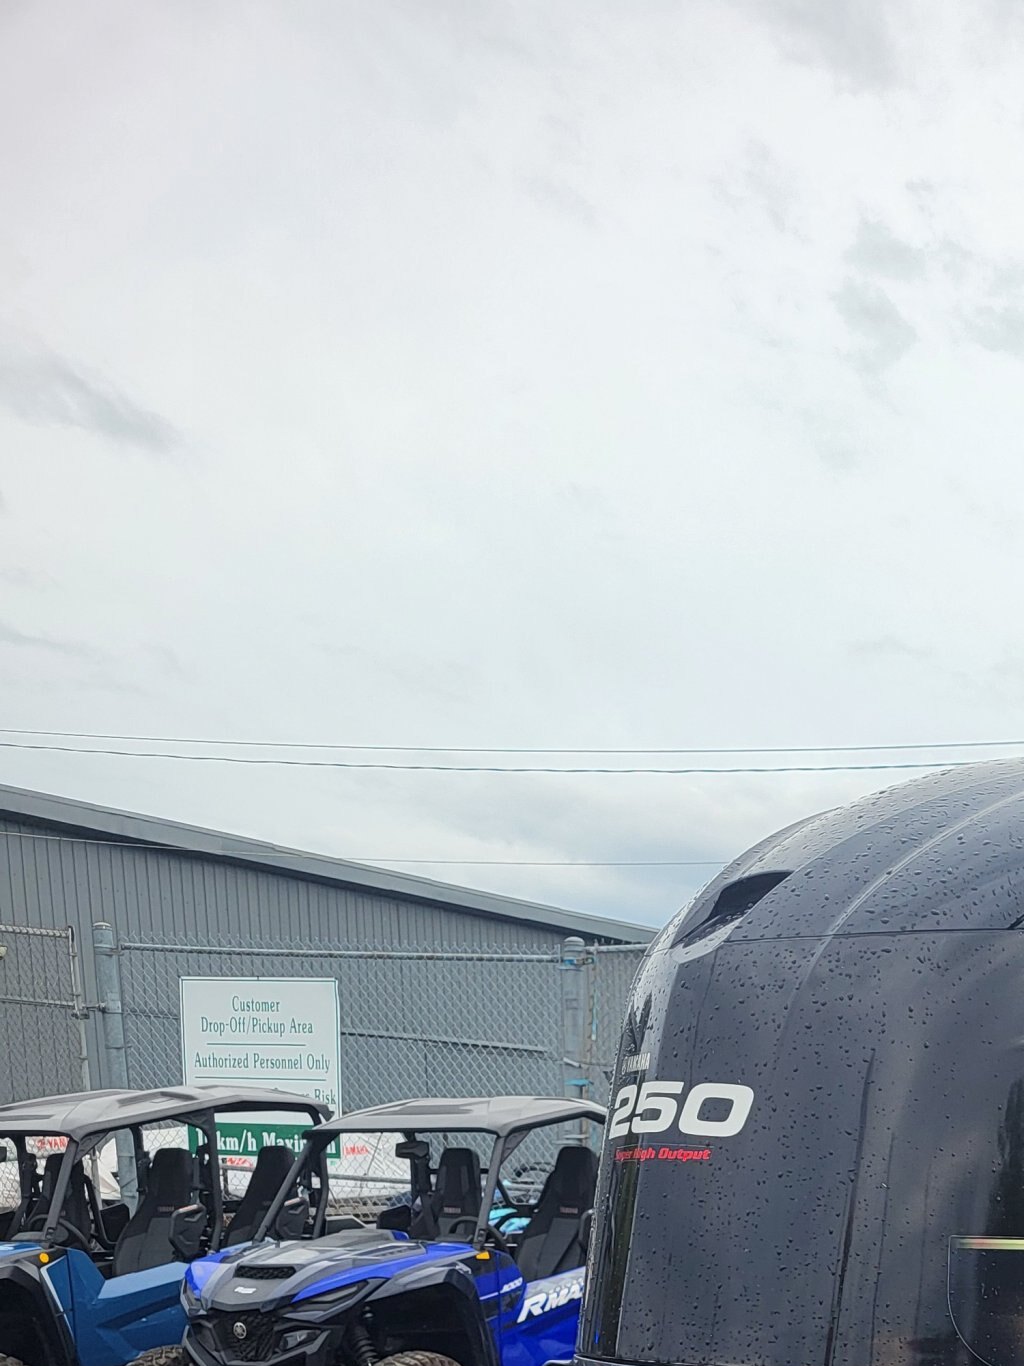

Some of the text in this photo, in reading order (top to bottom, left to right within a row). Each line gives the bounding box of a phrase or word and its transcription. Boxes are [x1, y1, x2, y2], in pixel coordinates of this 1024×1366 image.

[232, 995, 281, 1013] Customer
[201, 1015, 314, 1037] Drop-Off/Pickup Area
[194, 1052, 331, 1073] Authorized Personnel Only
[314, 1088, 336, 1105] Risk
[608, 1081, 755, 1139] 250
[216, 1129, 257, 1153] km/h
[633, 1147, 656, 1162] High
[658, 1147, 712, 1162] Output
